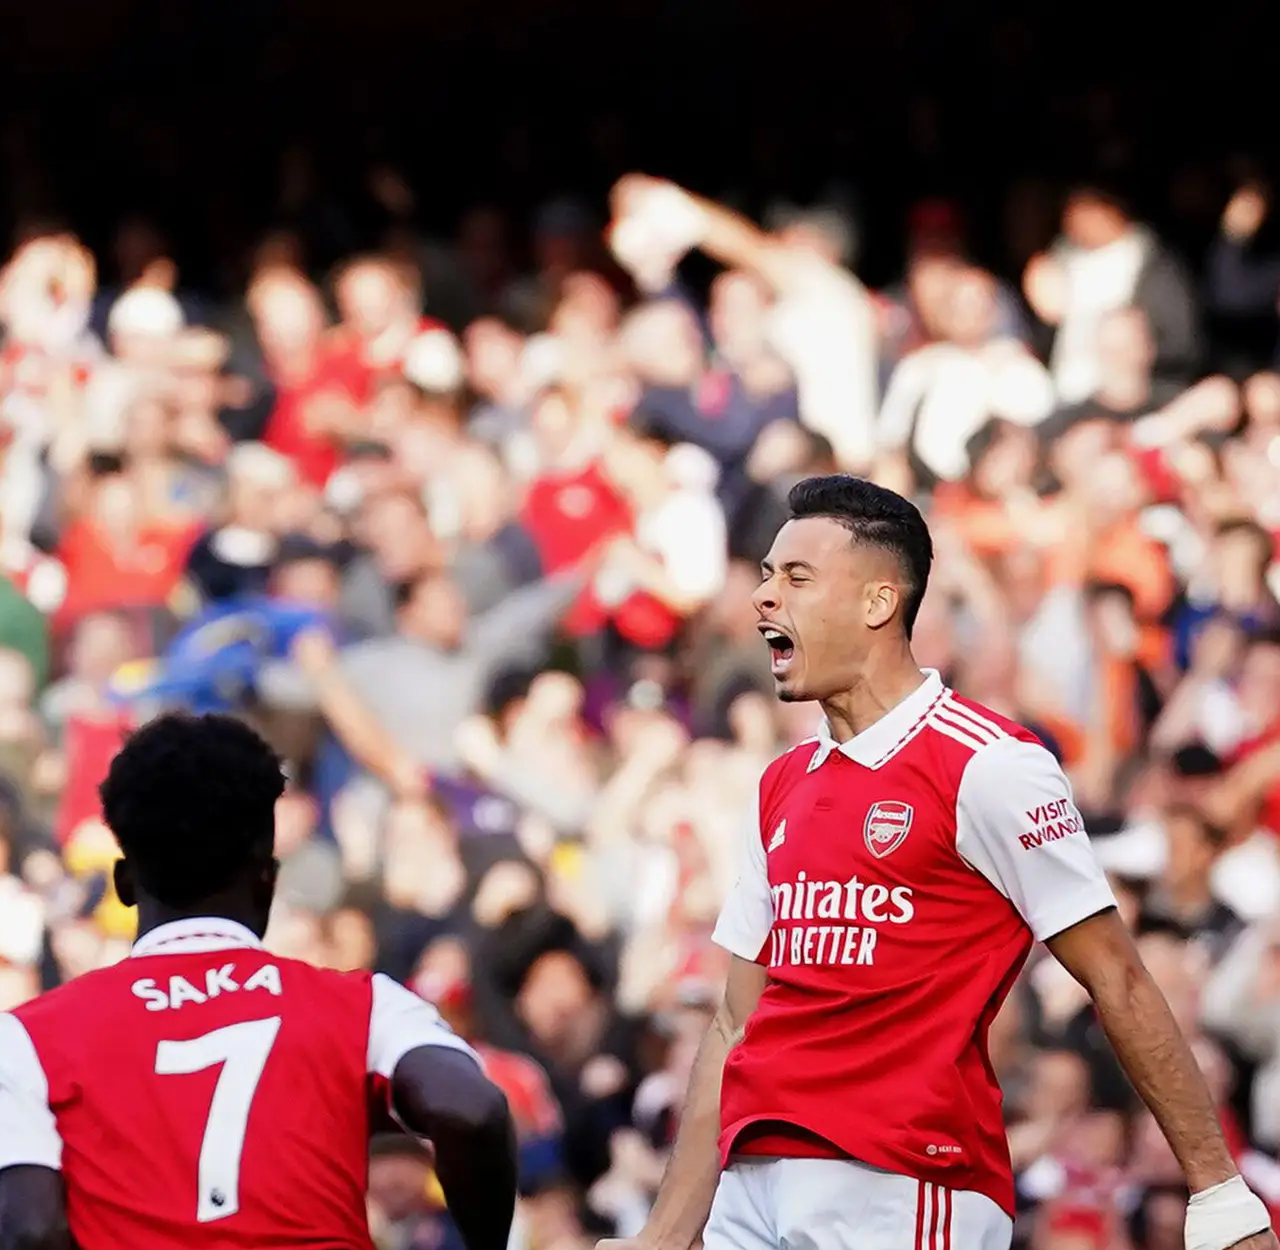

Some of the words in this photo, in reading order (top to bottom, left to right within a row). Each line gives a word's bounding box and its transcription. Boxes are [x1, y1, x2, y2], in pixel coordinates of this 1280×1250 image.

[1026, 798, 1067, 825] VISIT
[770, 870, 915, 924] mirates
[790, 926, 877, 966] BETTER
[131, 963, 283, 1011] SAKA
[154, 1015, 282, 1223] 7
